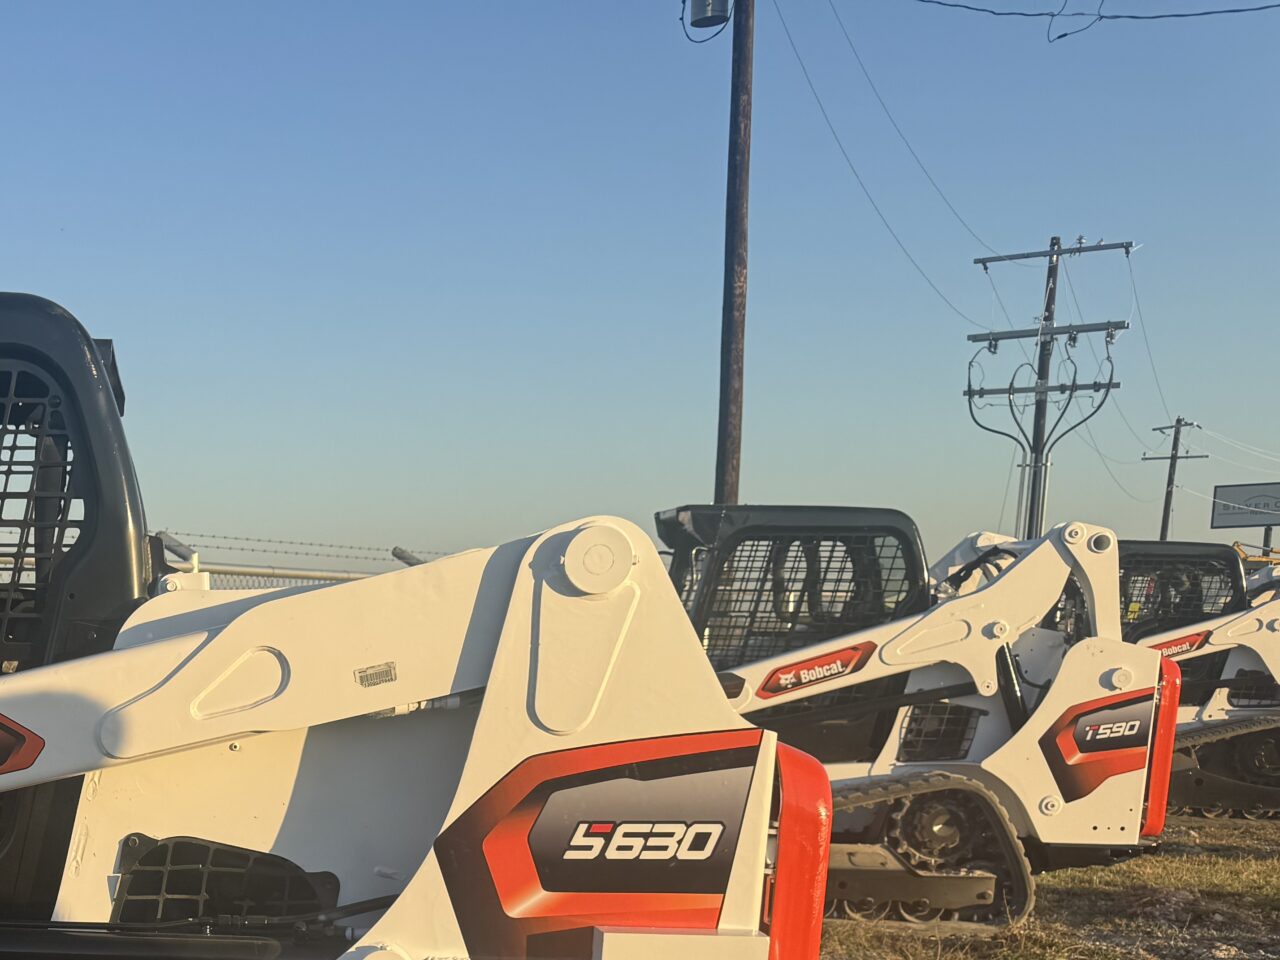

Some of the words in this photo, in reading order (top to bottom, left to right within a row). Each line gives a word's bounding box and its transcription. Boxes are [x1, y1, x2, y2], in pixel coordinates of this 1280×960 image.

[1162, 641, 1190, 656] Bobcat
[799, 660, 844, 684] Bobcat
[1085, 720, 1140, 741] T590
[563, 822, 725, 860] S630
